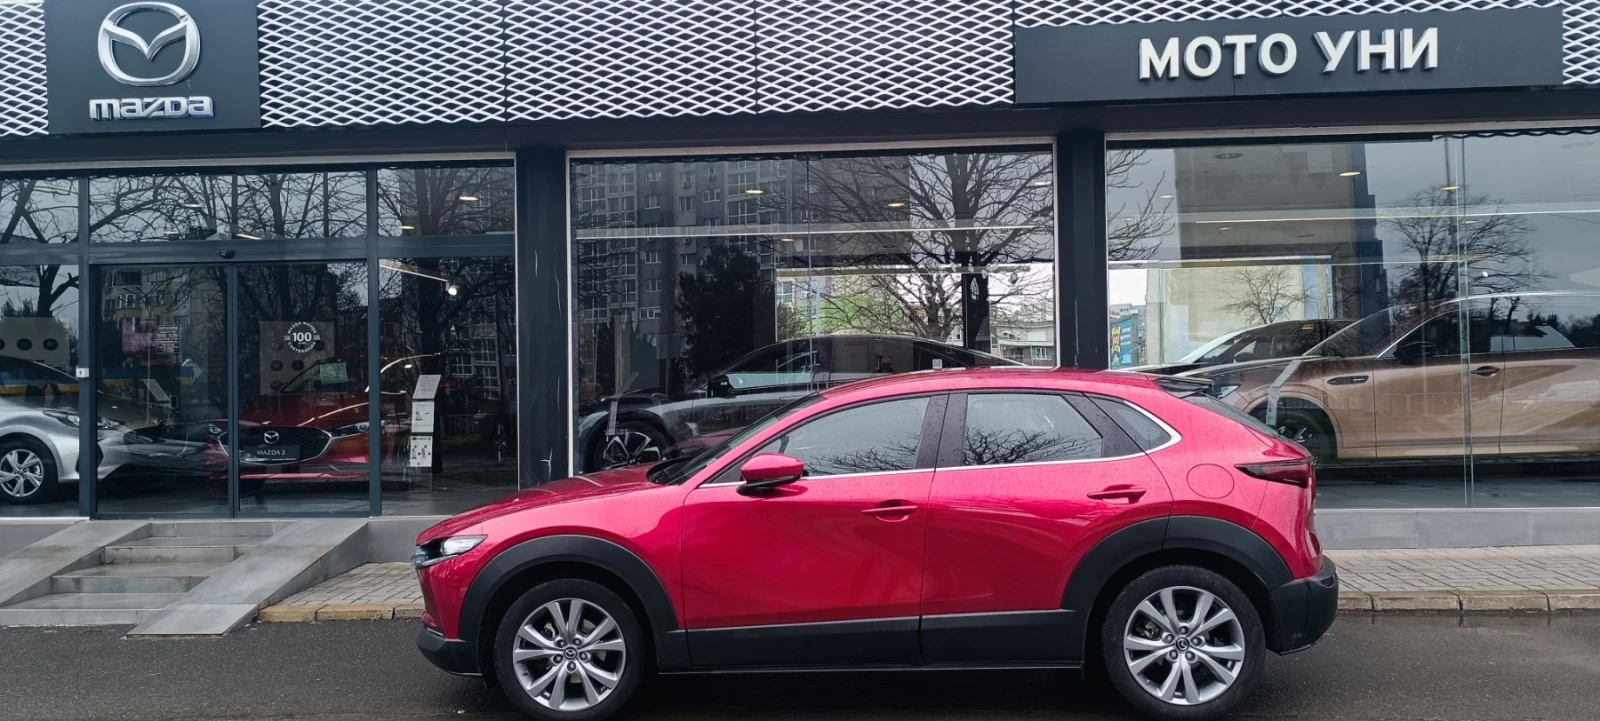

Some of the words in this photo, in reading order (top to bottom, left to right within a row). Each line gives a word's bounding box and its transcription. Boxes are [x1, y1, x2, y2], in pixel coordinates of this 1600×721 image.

[1139, 33, 1298, 79] МОТО
[1313, 27, 1439, 73] УНИ
[287, 321, 302, 334] MAZDA
[302, 321, 317, 334] MOTOR
[292, 332, 312, 342] 100
